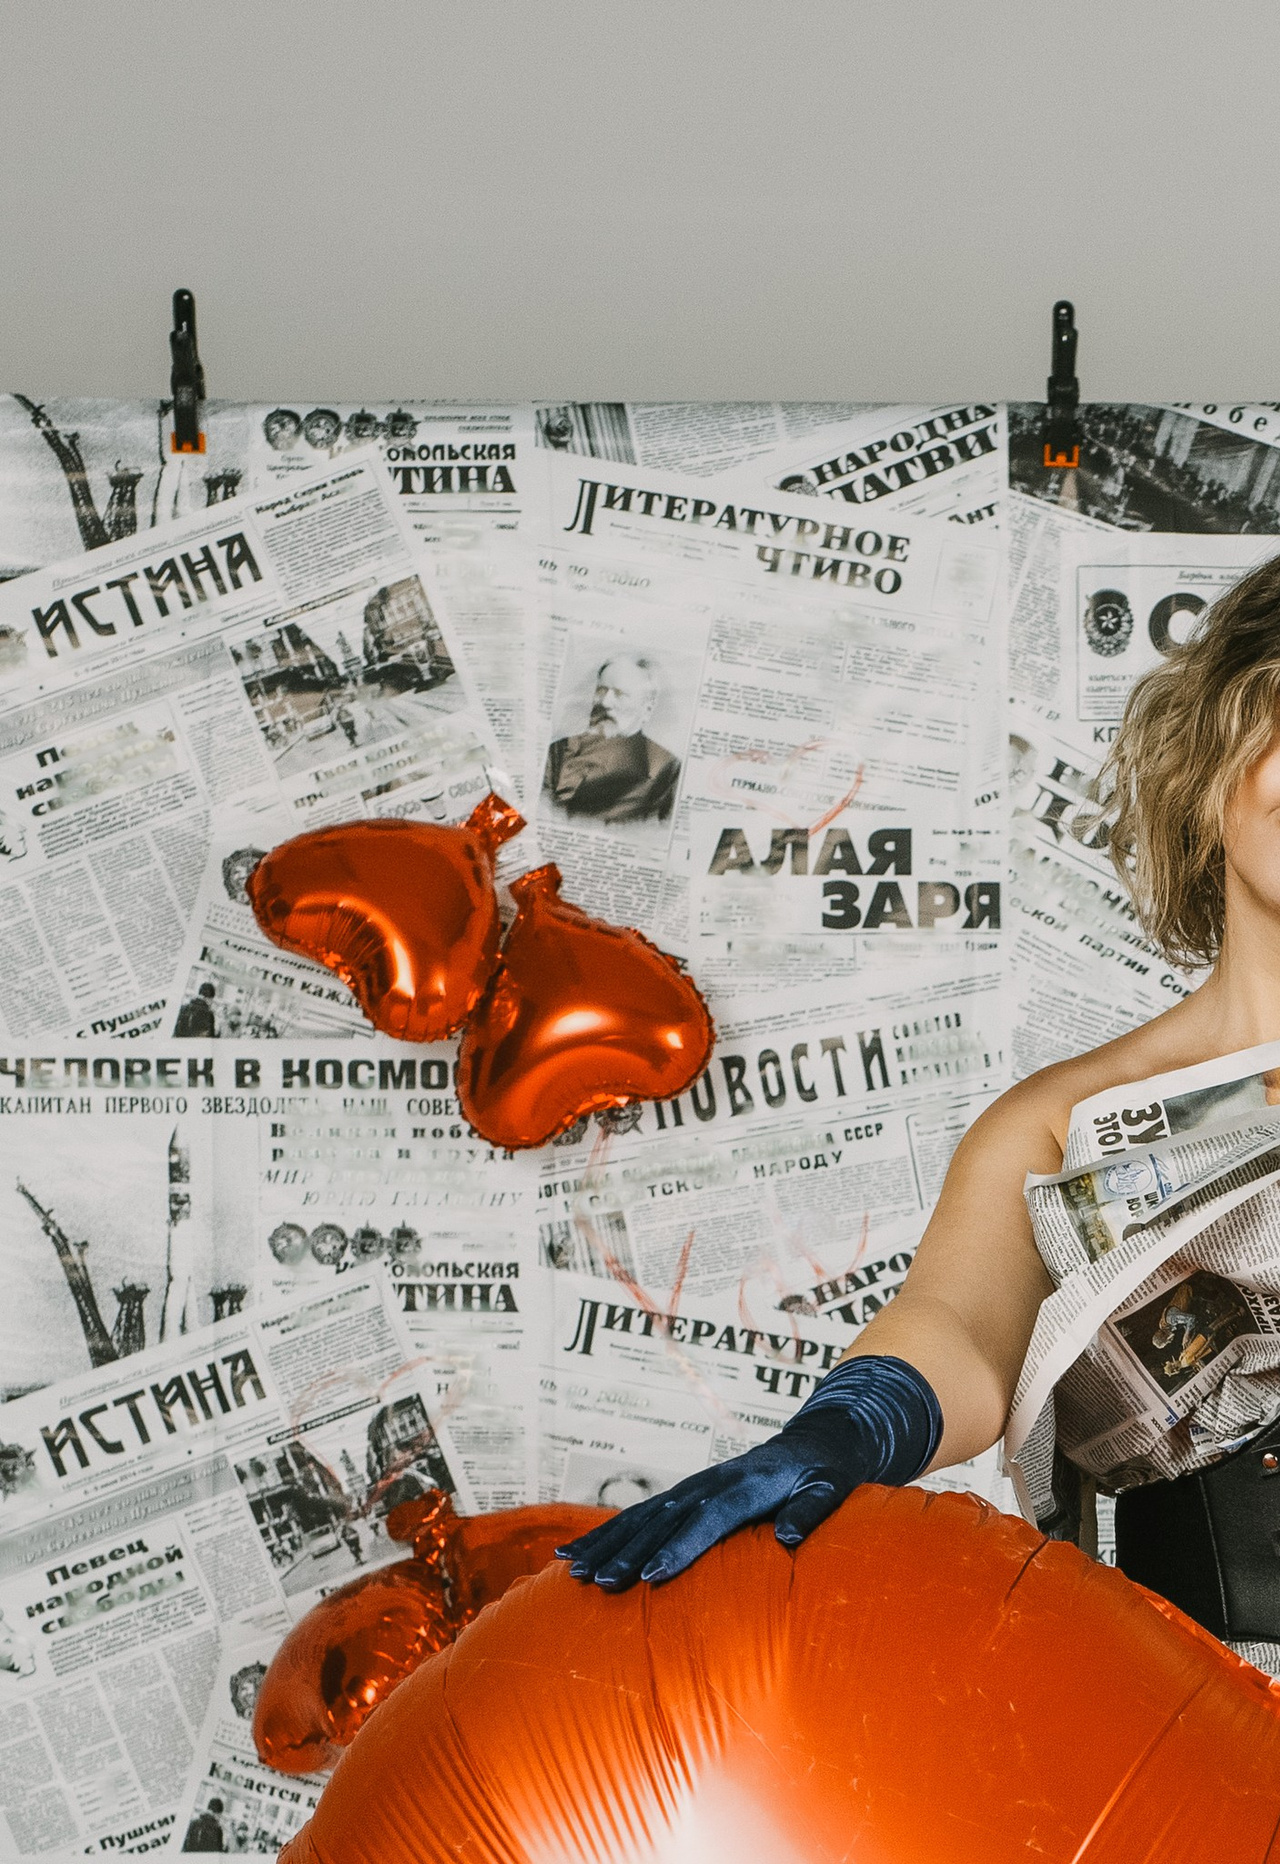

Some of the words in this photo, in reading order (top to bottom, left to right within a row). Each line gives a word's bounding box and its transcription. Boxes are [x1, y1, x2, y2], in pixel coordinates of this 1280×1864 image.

[387, 443, 517, 462] ОМОЛЬСКАЯ
[810, 403, 999, 486] НАРОДНА
[822, 422, 1000, 505] ЛАТВИ
[388, 466, 518, 494] ТИНА
[564, 478, 912, 564] ЛИТЕРАТУРНОЕ
[753, 543, 904, 596] ЧТИВО
[31, 531, 263, 659] ИСТИНА
[708, 827, 913, 876] АЛАЯ
[821, 881, 1002, 930] ЗАРЯ
[0, 1058, 214, 1089] ЧЕЛОВЕК
[235, 1058, 261, 1089] В
[282, 1058, 460, 1090] КОСМО
[0, 1097, 92, 1114] КАПИТАН
[105, 1096, 188, 1115] ПЕРВОГО
[1093, 1111, 1124, 1147] ЭТО
[844, 1122, 884, 1142] СССР
[753, 1149, 845, 1179] НАРОДУ
[392, 1283, 519, 1312] ТИНА
[40, 1348, 267, 1478] ИСТИНА
[46, 1538, 150, 1586] Певец
